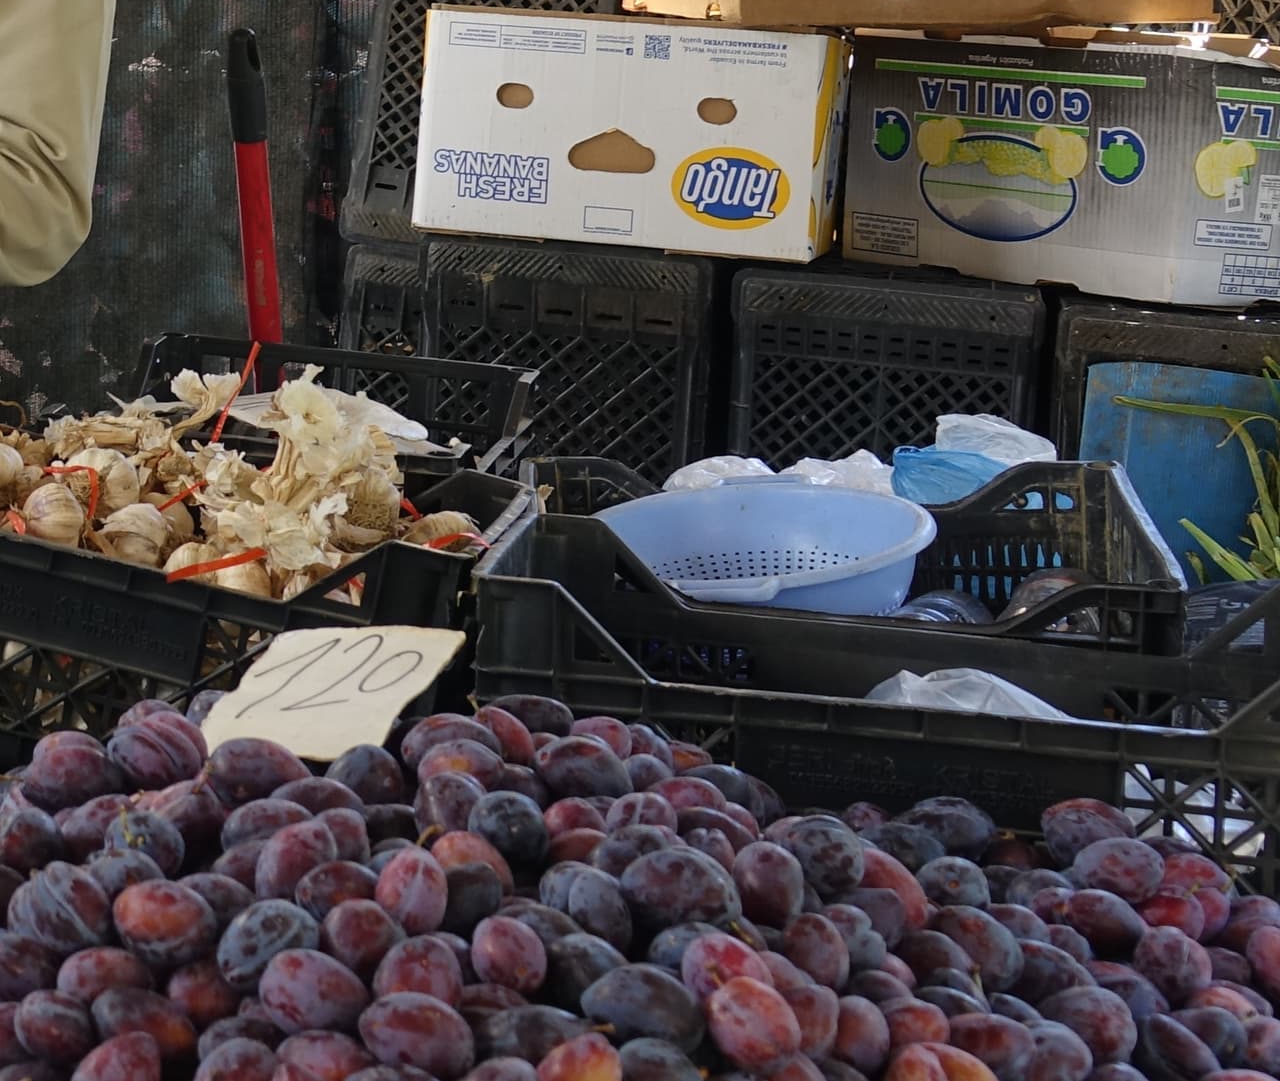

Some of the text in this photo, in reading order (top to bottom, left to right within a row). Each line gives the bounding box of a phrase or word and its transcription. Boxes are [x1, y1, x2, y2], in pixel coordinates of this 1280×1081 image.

[679, 36, 702, 44] quality
[917, 77, 1092, 124] GOMILA
[1216, 102, 1280, 138] LA
[434, 148, 550, 181] BANANAS
[458, 173, 548, 205] FRESH
[681, 157, 781, 220] Tango
[235, 634, 423, 719] 120
